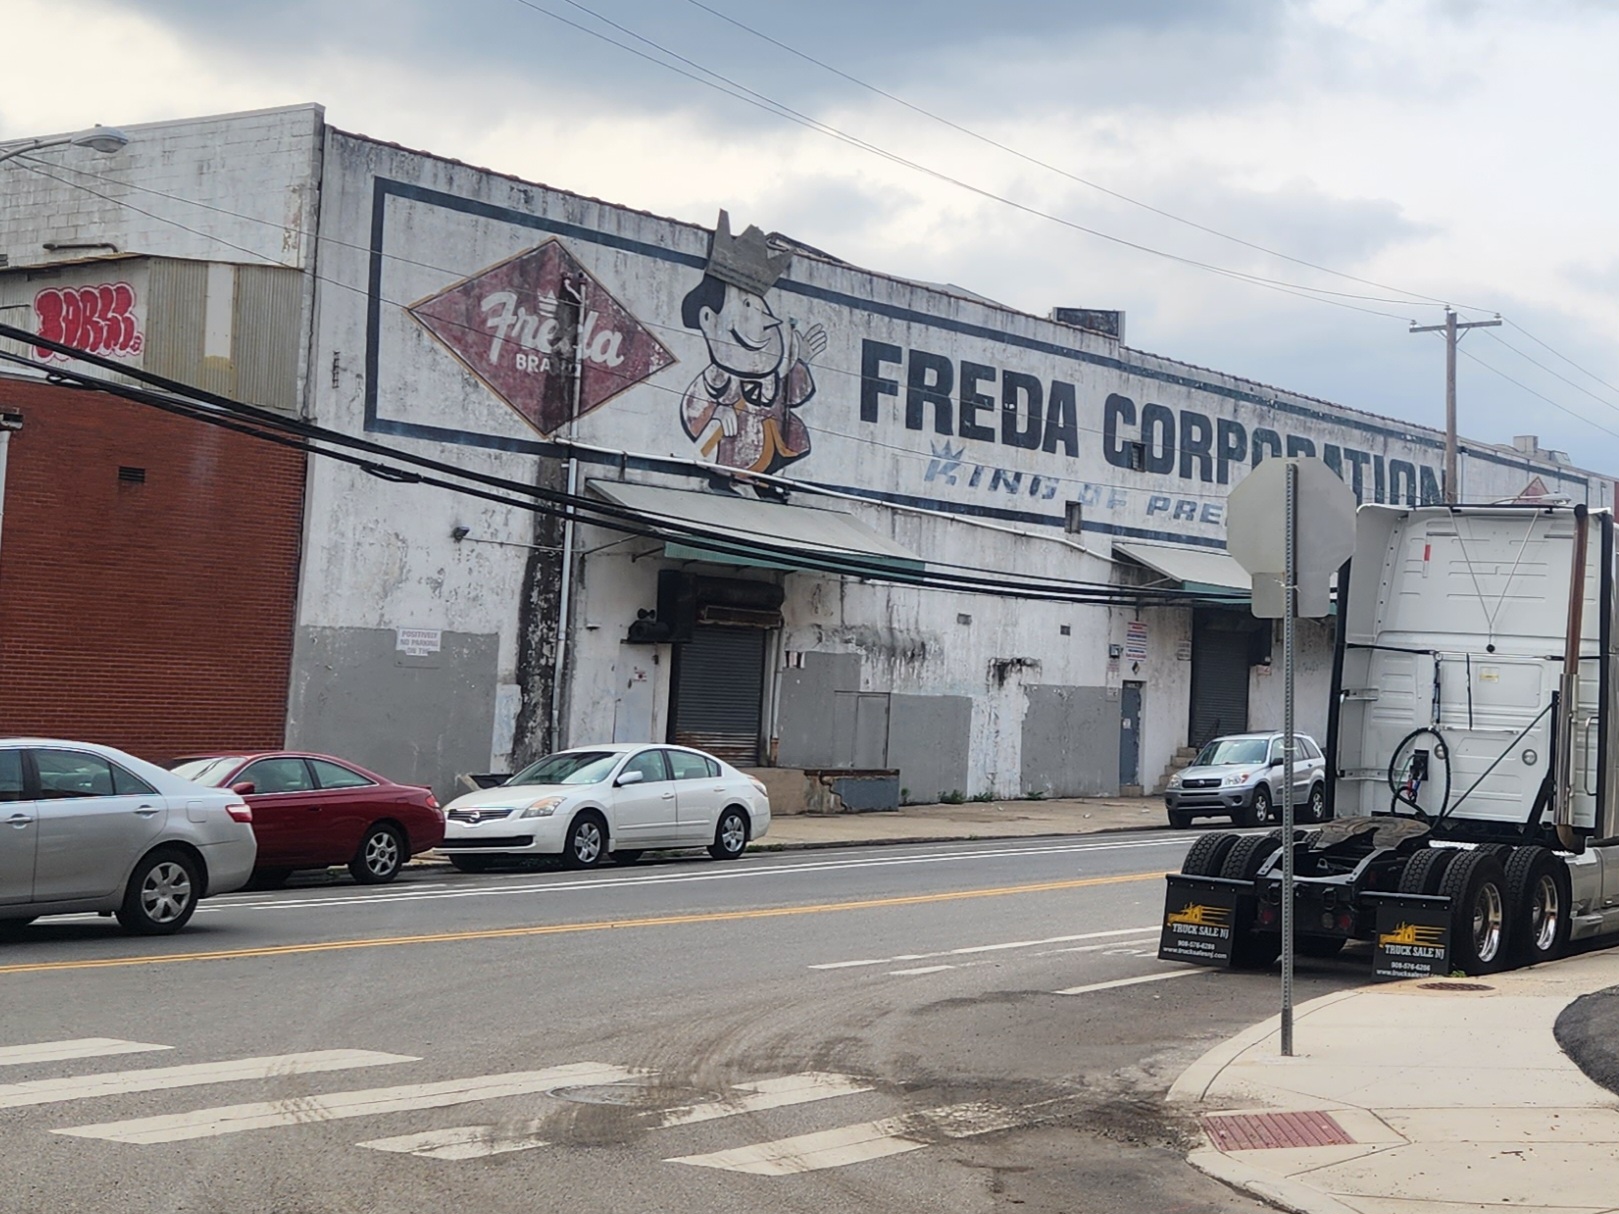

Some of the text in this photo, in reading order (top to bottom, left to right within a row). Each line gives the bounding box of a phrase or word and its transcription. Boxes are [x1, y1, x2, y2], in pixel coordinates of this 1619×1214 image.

[860, 338, 1080, 458] FREDA
[923, 438, 1060, 500] KING
[1078, 482, 1128, 510] OF
[400, 638, 410, 646] NO
[401, 630, 438, 639] POSITIVELY
[1172, 922, 1230, 940] TRUCK SALE NJ
[1384, 944, 1446, 960] TRUCK SALE NJ
